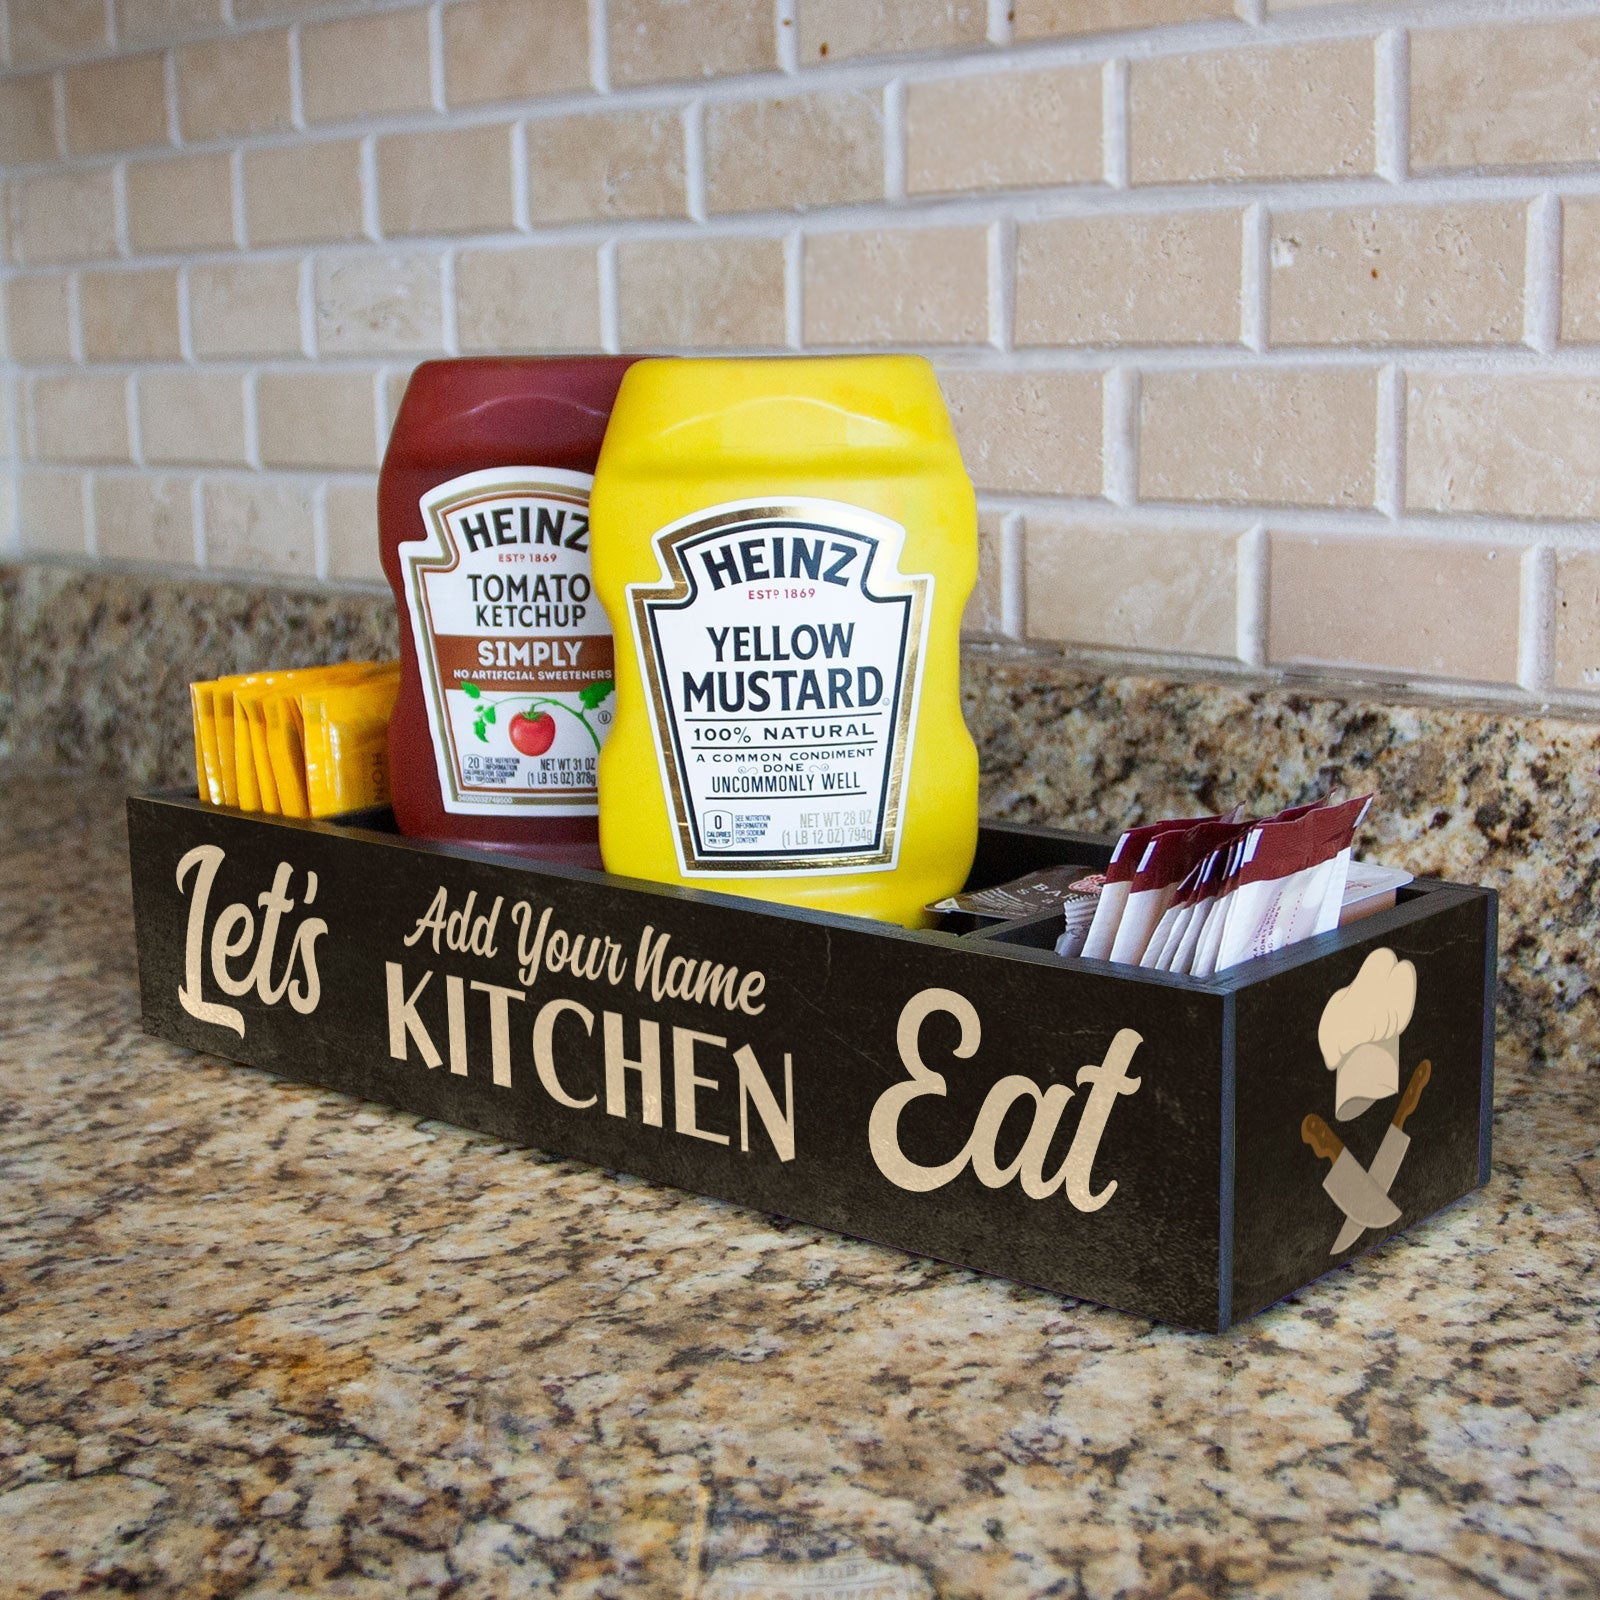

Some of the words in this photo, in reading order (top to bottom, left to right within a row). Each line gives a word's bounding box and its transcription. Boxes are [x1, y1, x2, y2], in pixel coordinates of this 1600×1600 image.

[459, 506, 589, 553] HEINZ
[530, 553, 557, 563] 1869
[700, 537, 858, 591] HEINZ
[467, 573, 590, 602] TOMATO
[785, 588, 815, 599] 1869
[475, 604, 586, 627] KETCHUP
[705, 622, 856, 662] YELLOW
[478, 640, 582, 667] SIMPLY
[453, 669, 469, 679] NO
[471, 670, 535, 680] ARTIFICIAL
[538, 670, 612, 680] SWEETENERS
[682, 666, 883, 712] MUSTARD
[694, 726, 751, 743] 100%
[764, 723, 874, 740] NATURAL
[468, 757, 480, 769] 20
[540, 758, 555, 770] NET
[558, 758, 571, 770] WT
[573, 758, 582, 770] 31
[585, 758, 596, 770] OZ
[696, 754, 706, 763] A
[712, 753, 781, 763] COMMON
[790, 748, 874, 761] CONDIMENT
[538, 772, 547, 784] LB
[763, 763, 804, 773] DONE
[712, 774, 815, 793] UNCOMMONLY
[821, 771, 861, 790] WELL
[746, 814, 771, 822] NUTRITION
[800, 813, 820, 828] NET
[823, 811, 841, 827] WT
[860, 809, 872, 825] OZ
[746, 829, 766, 837] SODIUM
[795, 830, 808, 846] LB
[812, 829, 824, 845] 12
[176, 844, 329, 1039] Let's
[404, 886, 504, 958] Add
[511, 901, 628, 986] Your
[635, 926, 766, 1016] Name
[386, 962, 795, 1163] KITCHEN
[868, 987, 1143, 1213] Eat
